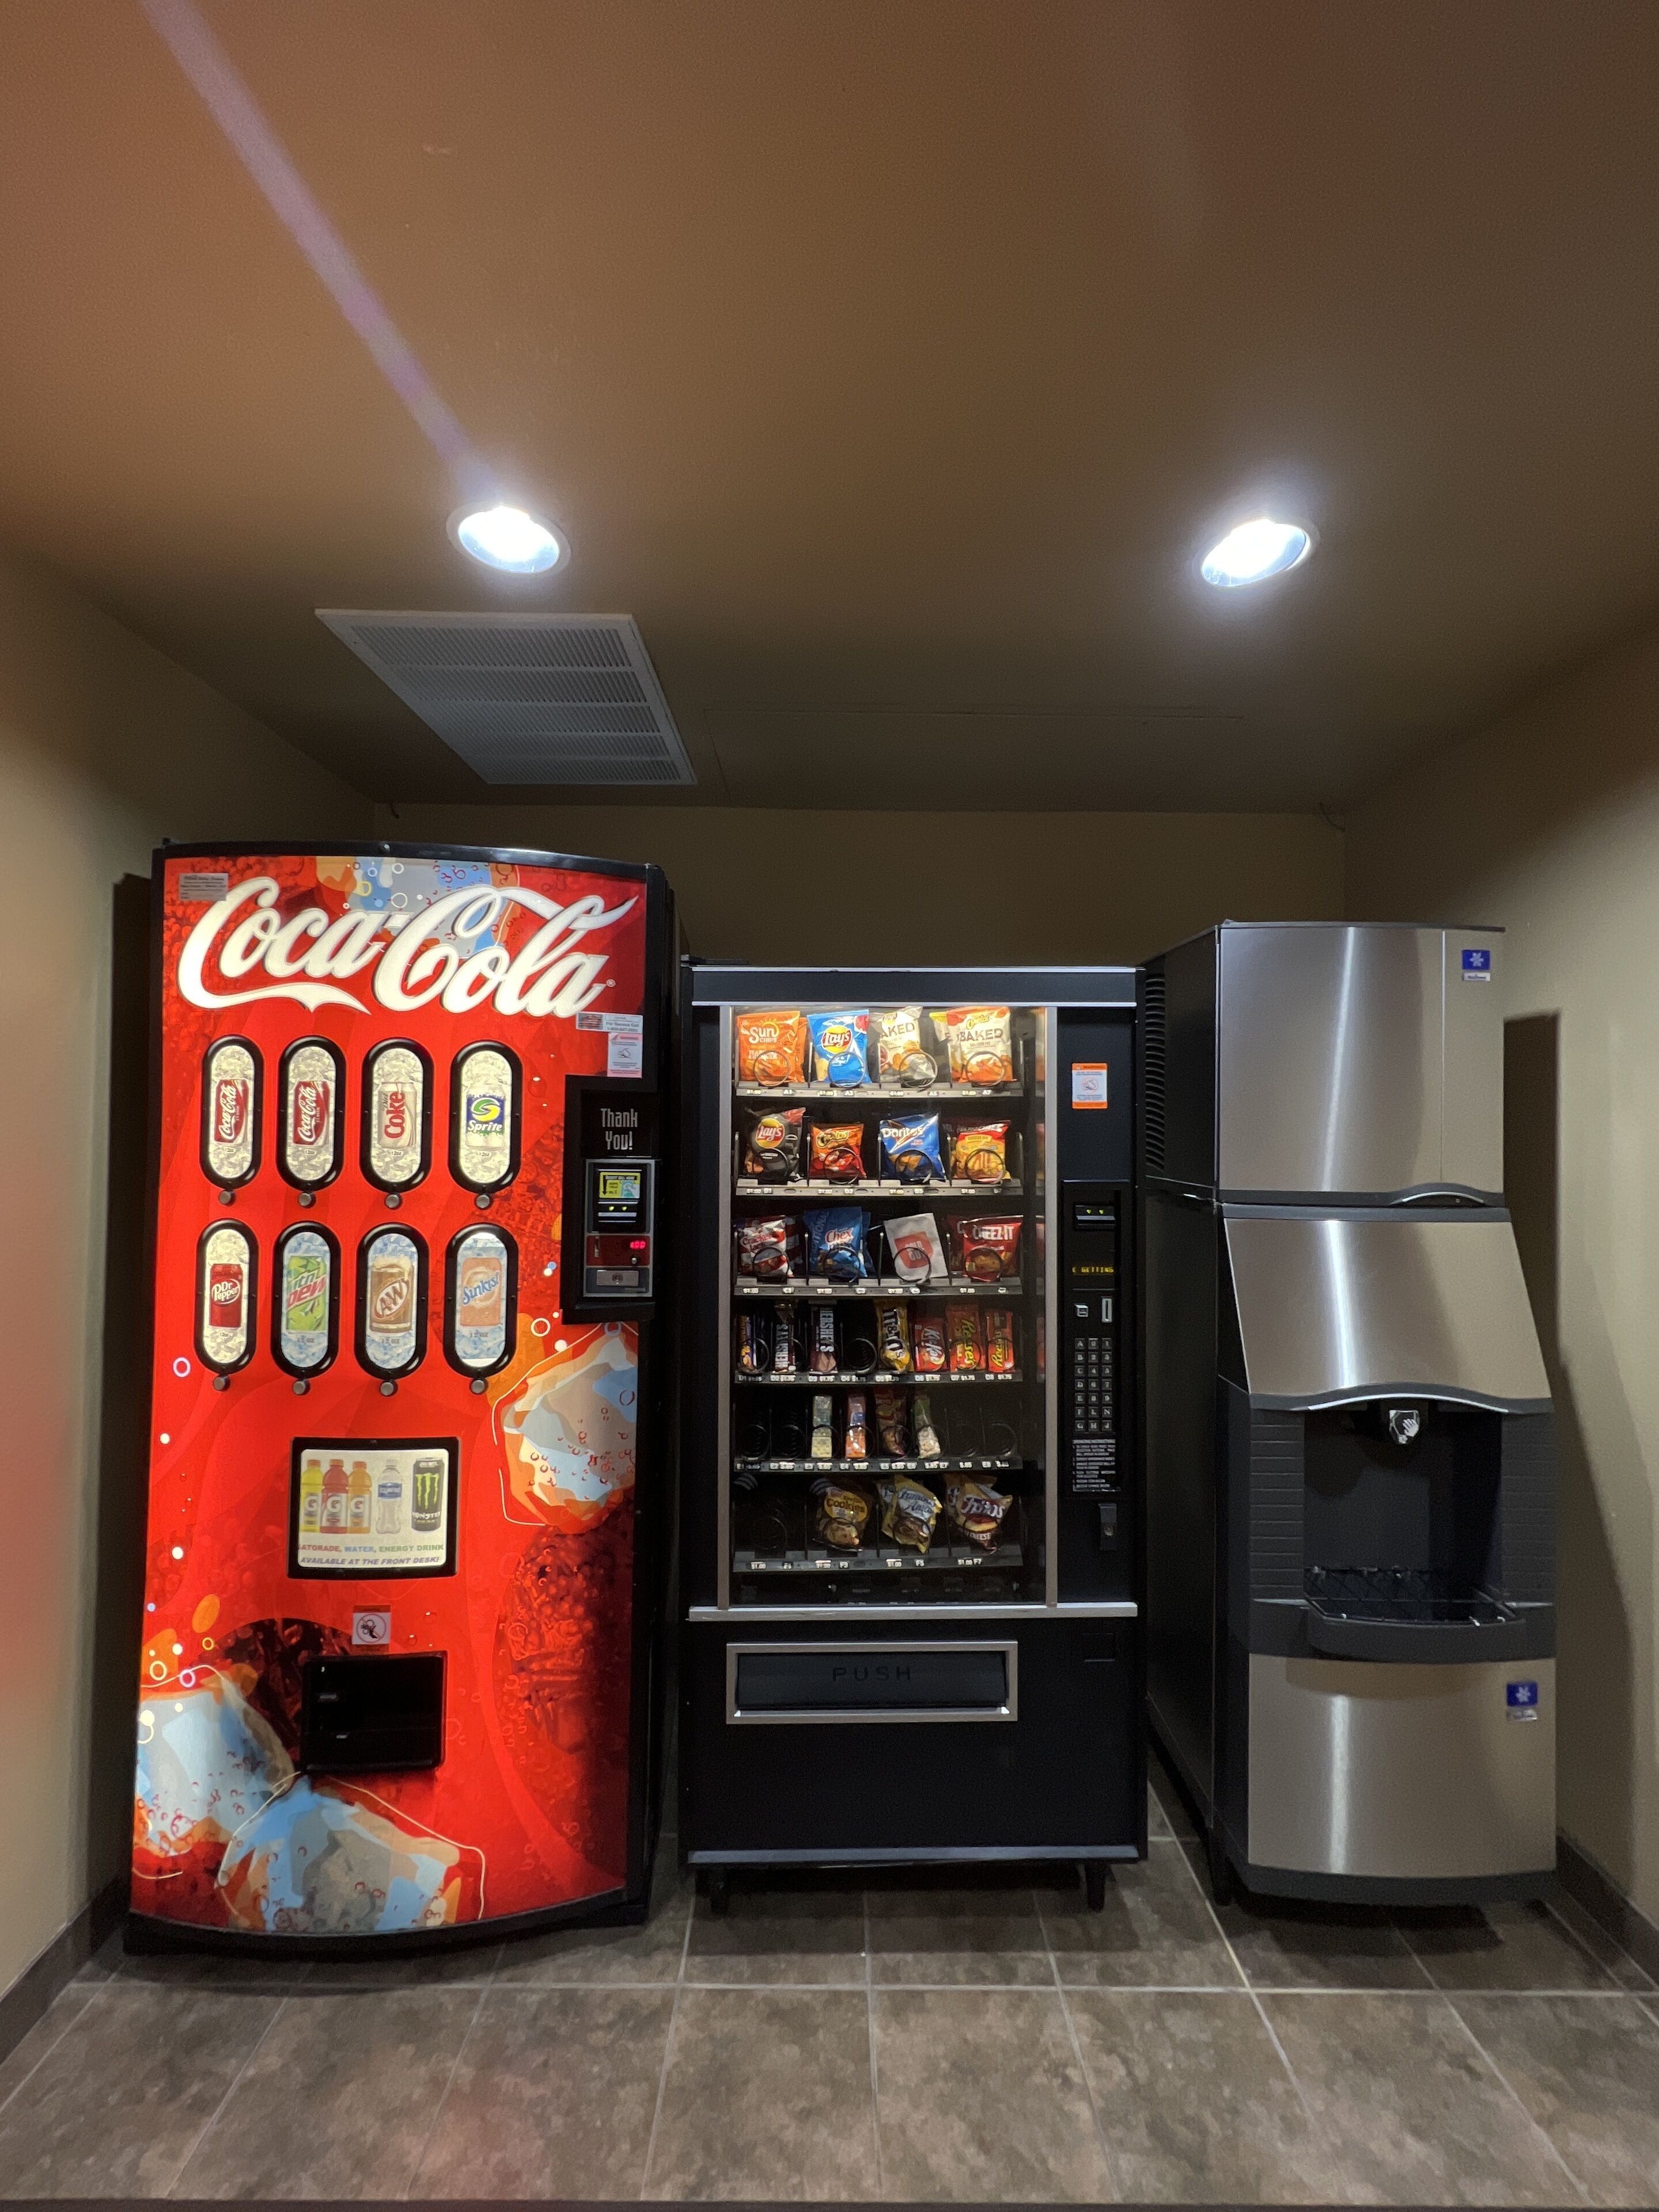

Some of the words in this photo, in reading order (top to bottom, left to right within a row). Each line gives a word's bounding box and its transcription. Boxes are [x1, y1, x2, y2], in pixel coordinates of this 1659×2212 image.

[177, 876, 639, 1017] Coca-Cola
[748, 1026, 779, 1044] Sun
[959, 1028, 1003, 1042] BAKED
[218, 1083, 237, 1140] Coca-Cola
[297, 1084, 317, 1142] Coca-Cola
[384, 1090, 407, 1139] Coke
[600, 1108, 638, 1127] Thank
[467, 1119, 503, 1134] Sprite
[880, 1127, 924, 1138] Doritos
[605, 1131, 633, 1150] You!
[825, 1227, 855, 1244] Chex
[212, 1283, 240, 1301] Pepper
[378, 1279, 404, 1314] A&W
[462, 1271, 500, 1305] Sunkist
[327, 1496, 341, 1513] G
[350, 1497, 365, 1513] G
[832, 1665, 911, 1682] PUSH
